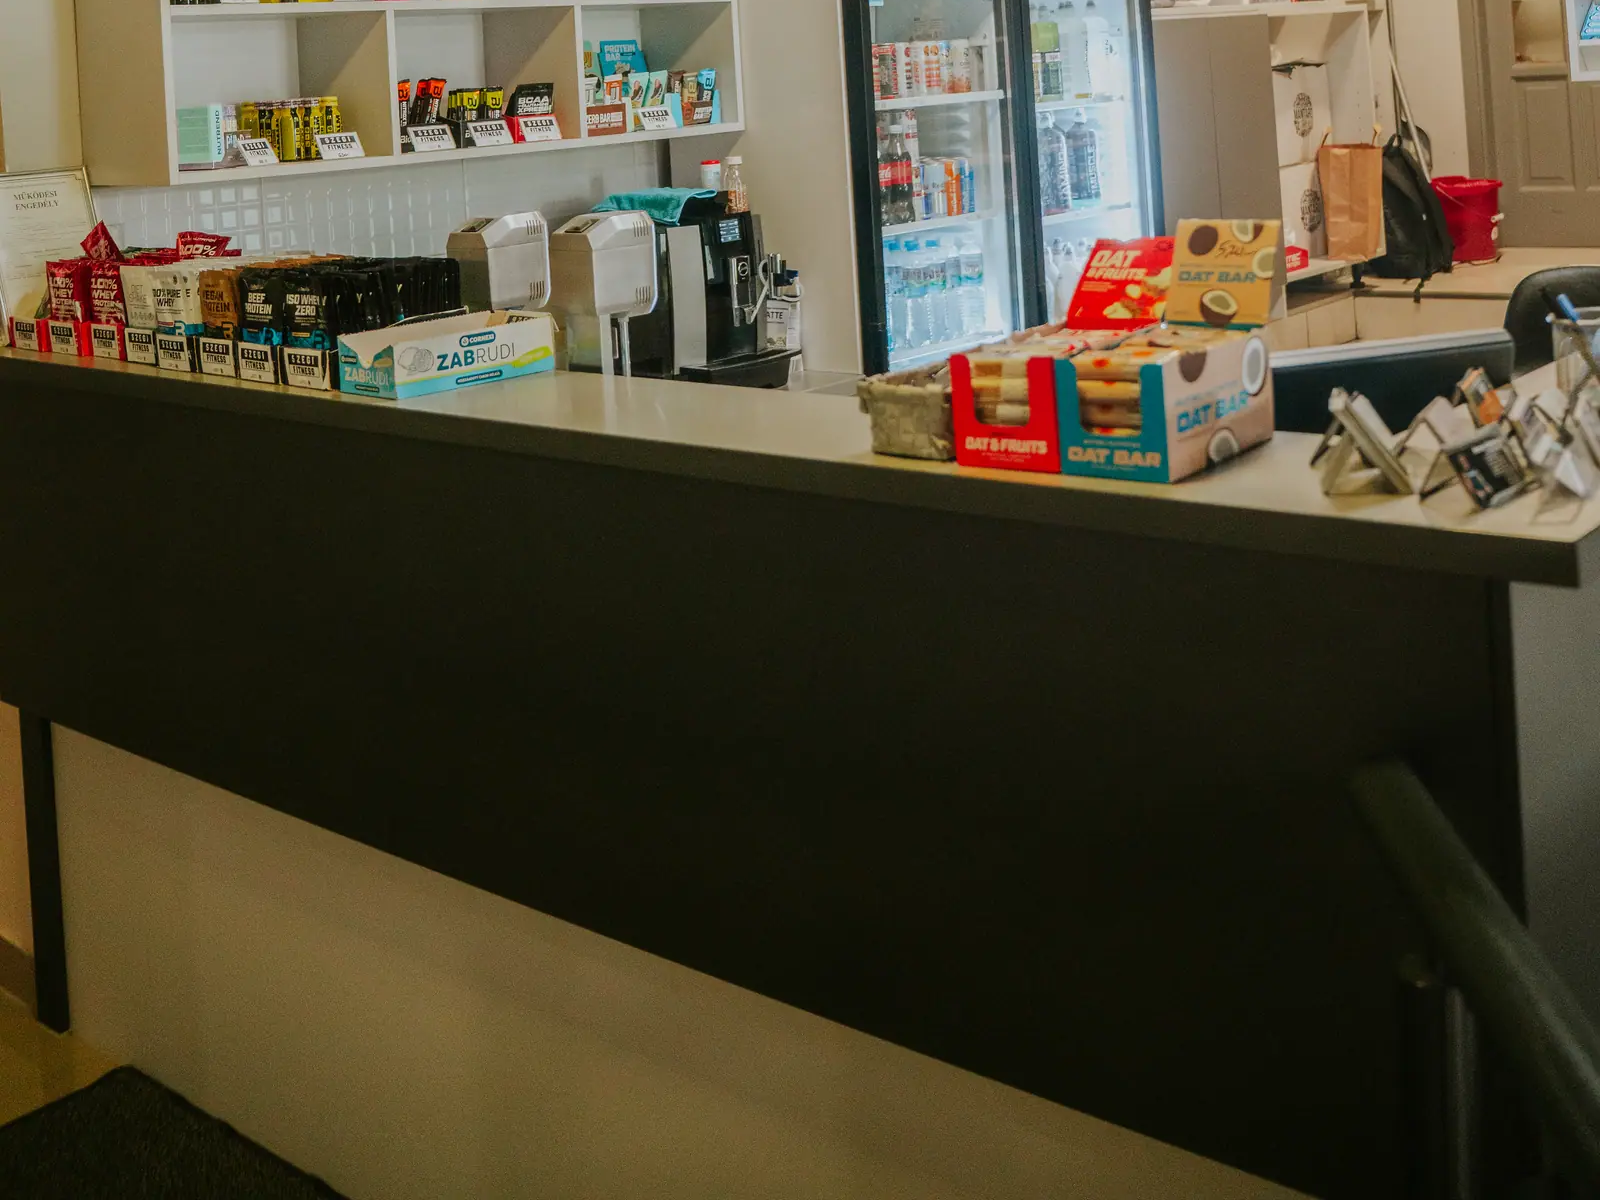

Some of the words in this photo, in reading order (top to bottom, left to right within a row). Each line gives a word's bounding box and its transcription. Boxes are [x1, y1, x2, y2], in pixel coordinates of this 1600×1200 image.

[518, 95, 549, 105] BCAA
[324, 136, 352, 144] SZEGI
[1090, 250, 1141, 268] OAT
[1178, 270, 1214, 282] OAT
[1216, 271, 1257, 283] BAR
[91, 277, 118, 289] 100%
[91, 289, 117, 299] WHEY
[247, 292, 266, 303] BEEF
[286, 293, 300, 305] ISO
[156, 297, 175, 307] WHEY
[294, 305, 316, 316] ZERO
[767, 311, 783, 320] ATTE
[53, 327, 71, 336] SZEGI
[95, 329, 113, 339] SZEGI
[55, 336, 71, 345] FITNESS
[130, 334, 149, 343] SZEGI
[97, 339, 113, 349] FITNESS
[132, 343, 150, 353] FITNESS
[161, 340, 181, 349] SZEGI
[205, 343, 227, 353] SZEGI
[163, 350, 182, 360] FITNESS
[206, 353, 227, 364] FITNESS
[243, 350, 265, 360] SZEGI
[436, 342, 515, 372] ZABRUDI
[245, 360, 266, 371] FITNESS
[291, 355, 315, 366] SZEGI
[292, 365, 315, 376] FITNESS
[344, 367, 389, 387] ZABRUDI
[1176, 403, 1211, 434] OAT
[1215, 391, 1251, 420] BAR
[1067, 445, 1110, 465] OAT
[1112, 450, 1162, 468] BAR
